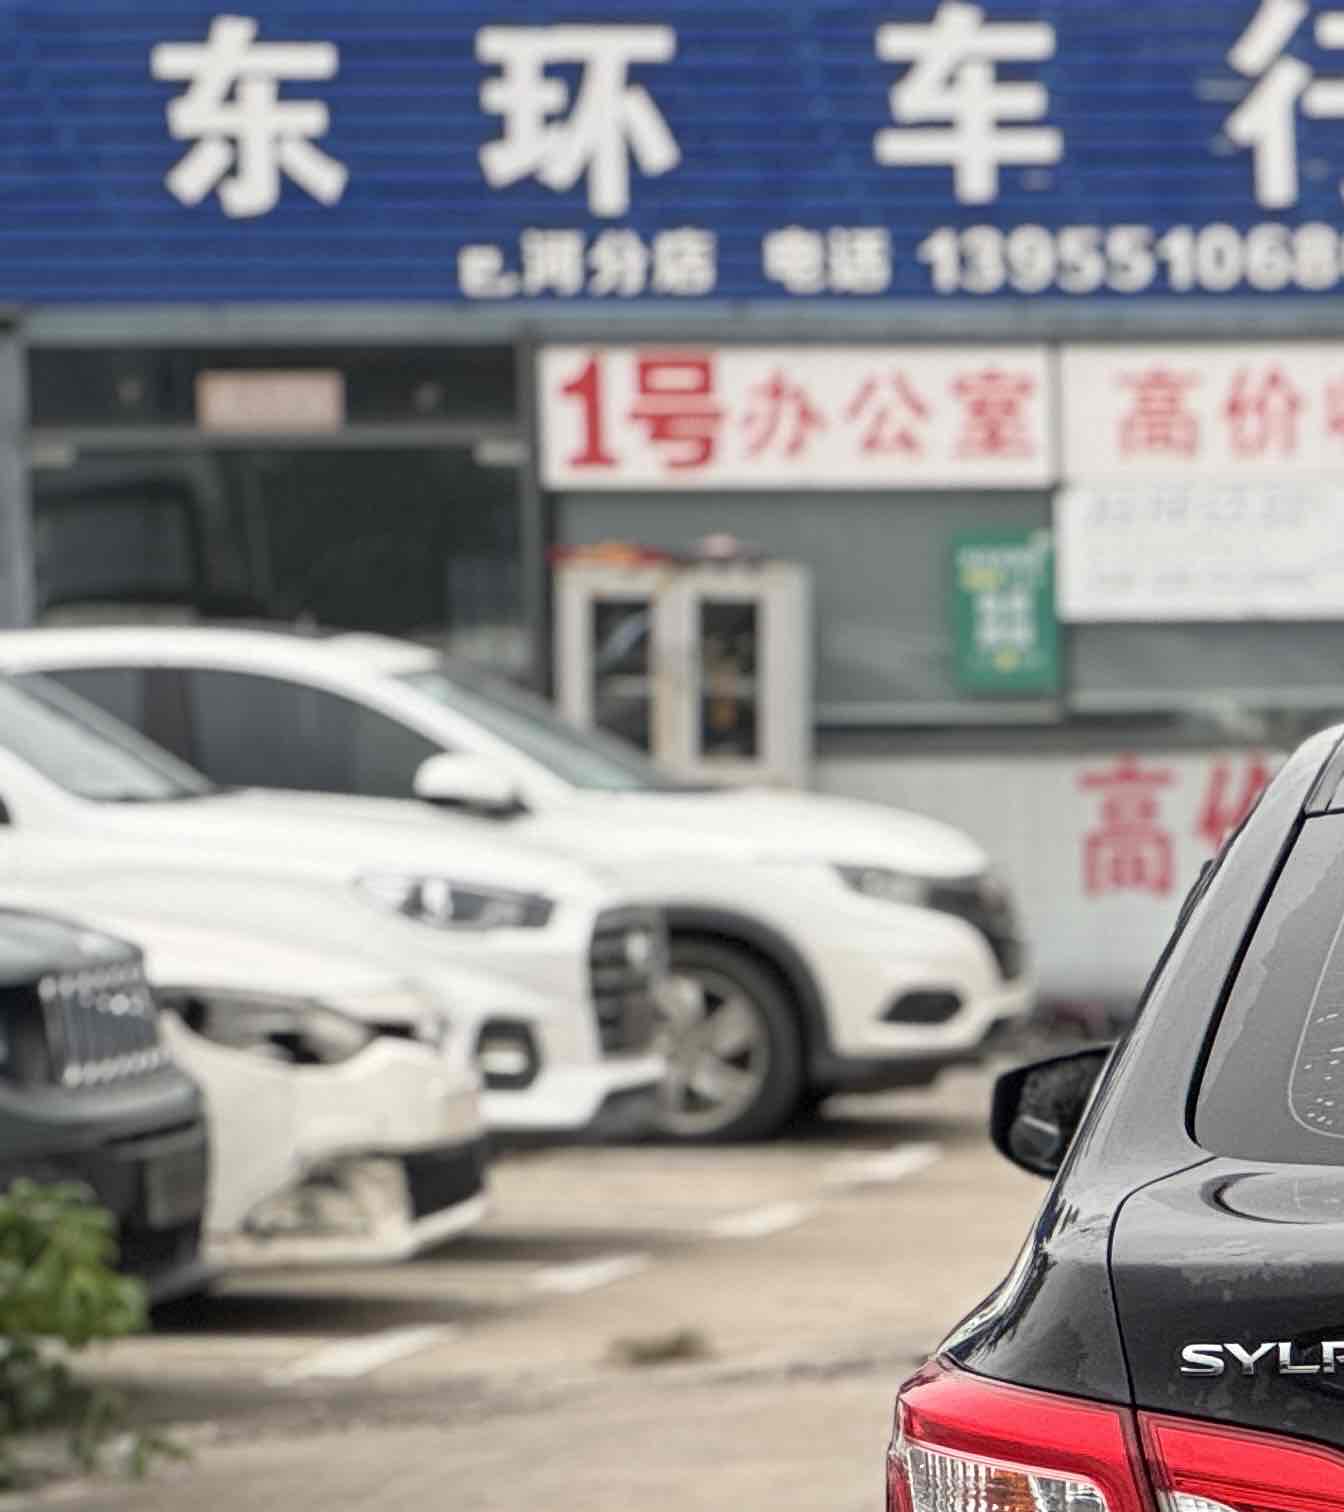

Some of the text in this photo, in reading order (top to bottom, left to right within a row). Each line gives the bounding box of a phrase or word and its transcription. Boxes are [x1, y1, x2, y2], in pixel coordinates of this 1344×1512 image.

[763, 225, 892, 293] 电话
[560, 350, 1036, 472] 1号办公室
